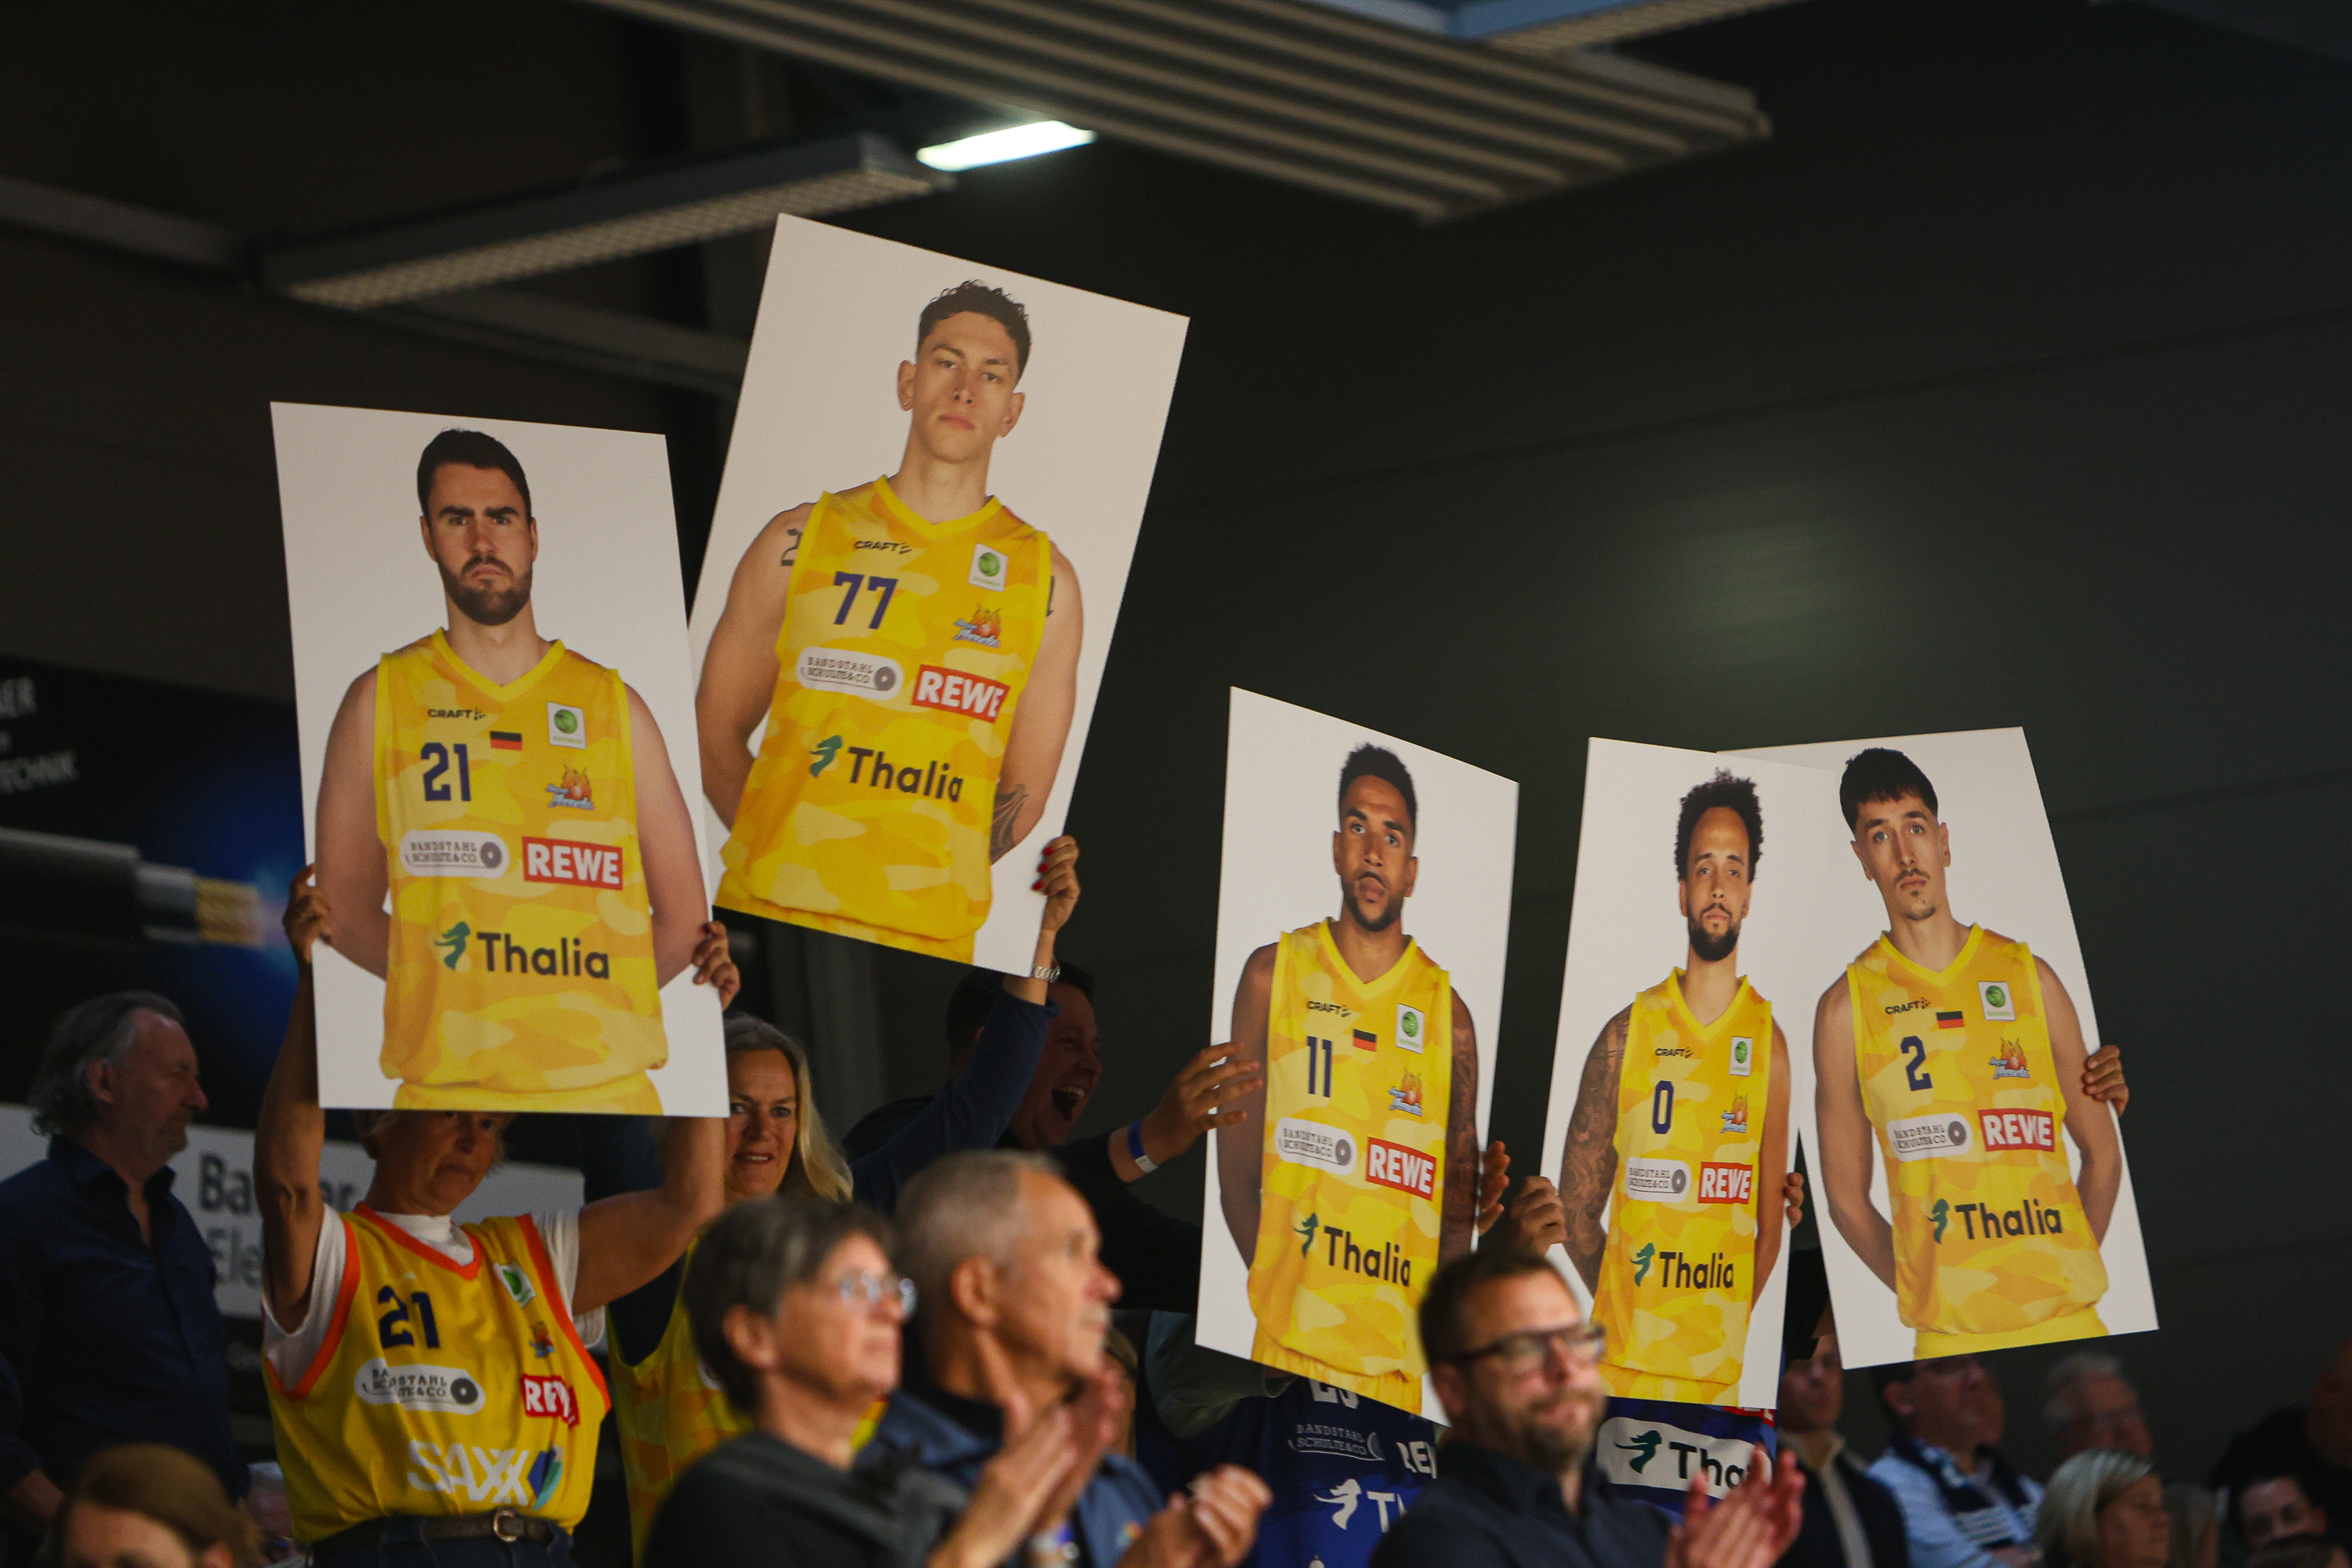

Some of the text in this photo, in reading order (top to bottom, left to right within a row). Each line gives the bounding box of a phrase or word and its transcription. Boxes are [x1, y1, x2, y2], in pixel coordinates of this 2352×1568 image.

[854, 539, 898, 553] CRAFT
[833, 571, 898, 630] 77
[427, 709, 473, 720] CRAFT
[916, 670, 1004, 719] REWE
[420, 742, 472, 802] 21
[848, 746, 964, 802] Thalia
[527, 843, 619, 884] REWE
[477, 931, 609, 978] Thalia
[1306, 1000, 1341, 1015] CRAFT
[1885, 1000, 1920, 1014] CRAFT
[1306, 1036, 1333, 1098] 11
[1655, 1047, 1685, 1058] CRAFT
[1900, 1036, 1933, 1091] 2
[1652, 1080, 1674, 1134] 0
[1982, 1113, 2053, 1147] REWE
[1369, 1145, 1433, 1195] REWE
[1700, 1167, 1751, 1199] REWE
[1955, 1198, 2063, 1240] Thalia
[1323, 1225, 1410, 1287] Thalia
[1659, 1251, 1733, 1289] Thalia
[378, 1285, 440, 1348] 21
[1297, 1425, 1364, 1443] BANDSTAHL
[407, 1439, 529, 1506] SAXX
[1669, 1441, 1746, 1488] Tha
